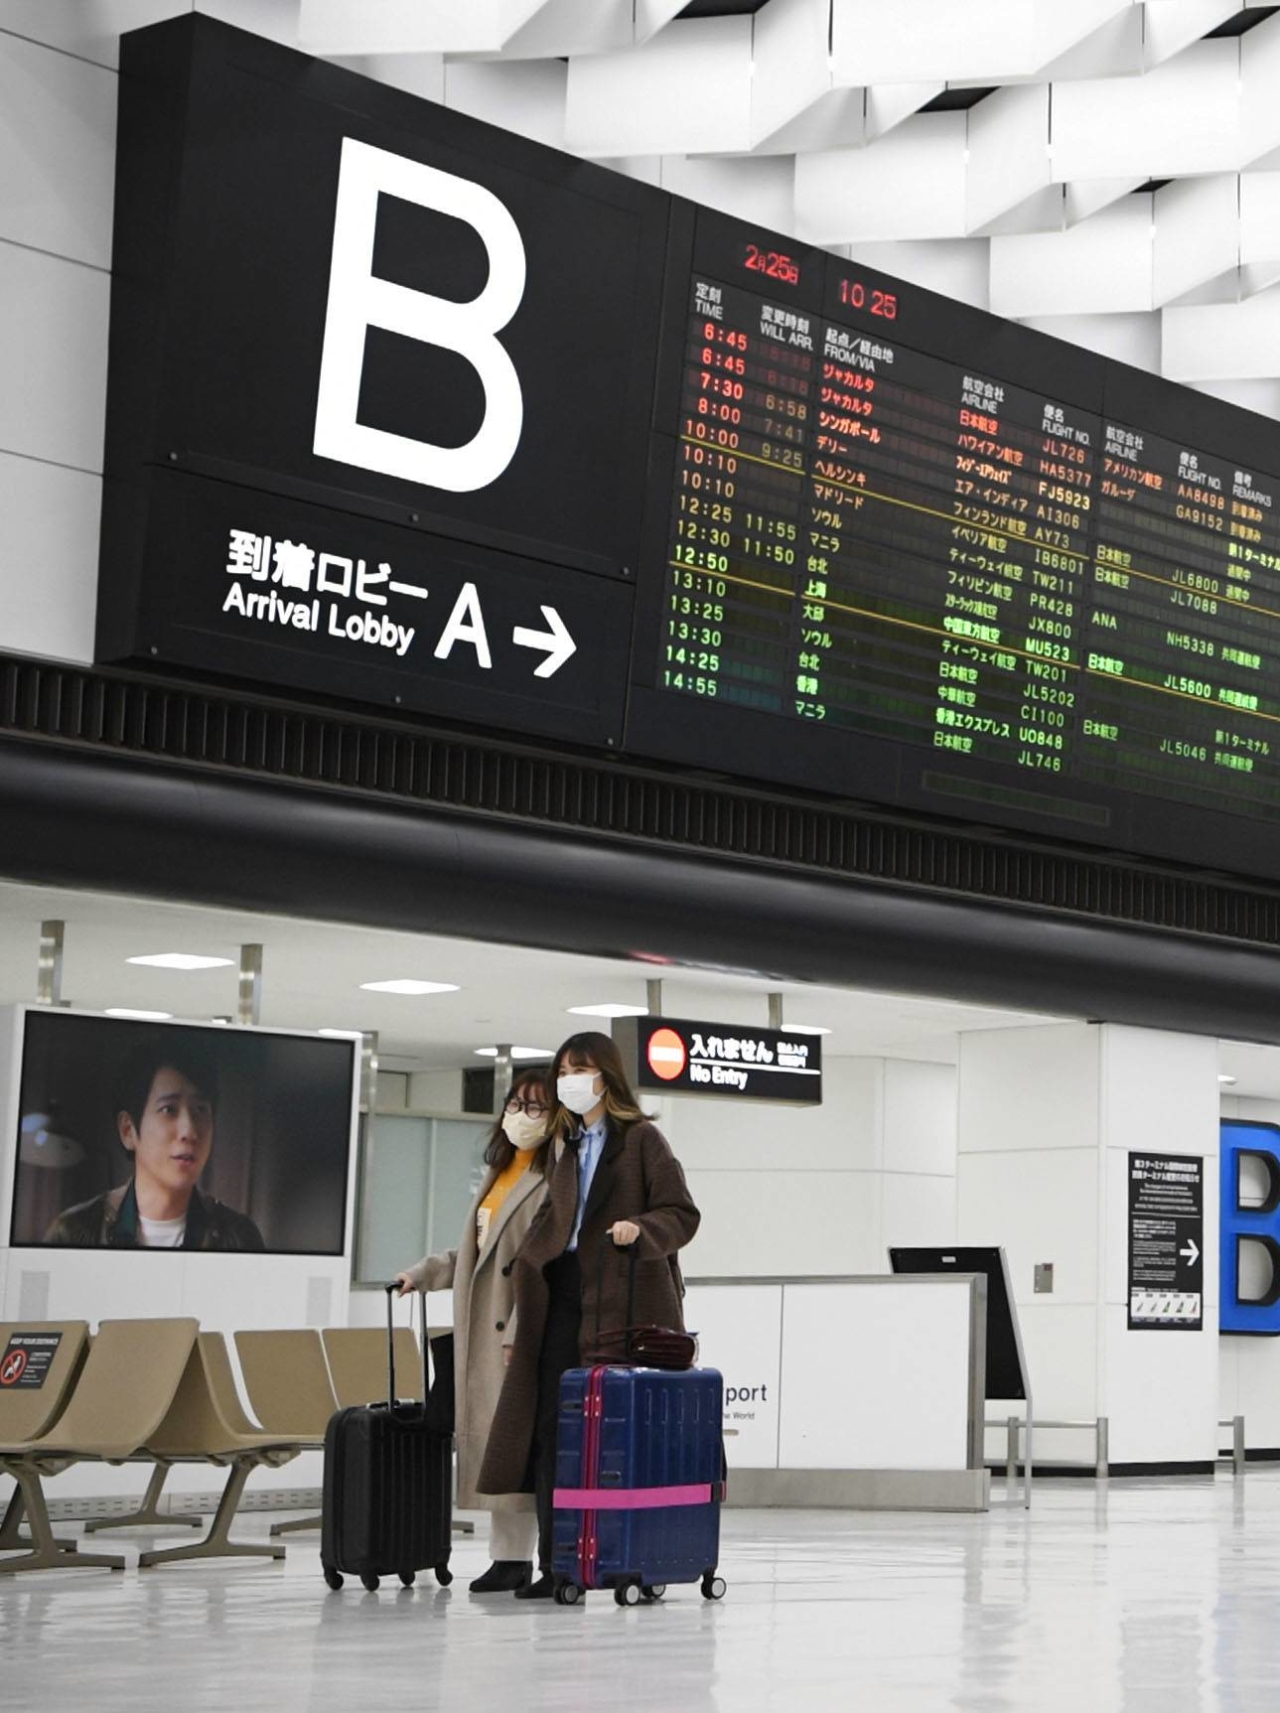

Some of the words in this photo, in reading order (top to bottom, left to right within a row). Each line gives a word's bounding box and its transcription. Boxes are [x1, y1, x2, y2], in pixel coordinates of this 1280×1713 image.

[312, 135, 526, 493] B
[695, 300, 723, 320] TIME
[760, 320, 786, 342] WILL
[961, 392, 997, 414] AIRLINE
[1042, 419, 1073, 440] FLIGHT
[1104, 441, 1137, 462] AIRLINE
[1178, 466, 1206, 485] FLIGHT
[1232, 485, 1271, 507] REMARKS
[699, 398, 740, 424] 8:00
[1037, 505, 1080, 529] AI306
[701, 373, 743, 400] 7:30
[1039, 481, 1090, 510] FJ5923
[702, 348, 745, 376] 6:45
[1040, 460, 1091, 487] HA5377
[1176, 505, 1223, 531] GA9152
[705, 322, 747, 351] 6:45
[1043, 439, 1084, 463] JL726
[1178, 484, 1225, 510] AA8498
[226, 529, 428, 606] 到着ロビー
[682, 470, 734, 499] 10:10
[1032, 571, 1073, 594] TW211
[684, 445, 736, 474] 10:10
[1035, 549, 1083, 575] IB6801
[1170, 591, 1217, 615] JL7088
[686, 419, 739, 448] 10:00
[1035, 527, 1069, 548] AY73
[1172, 569, 1219, 594] JL6800
[222, 582, 319, 631] Arrival
[329, 603, 415, 656] Lobby
[434, 581, 492, 669] A
[673, 570, 726, 597] 13:10
[1026, 660, 1067, 682] TW201
[675, 545, 728, 572] 12:50
[1025, 637, 1070, 661] MU523
[1164, 674, 1211, 698] JL5600
[678, 520, 730, 547] 12:30
[744, 538, 794, 565] 11:50
[1029, 616, 1071, 638] JX800
[680, 495, 732, 523] 12:25
[746, 513, 795, 540] 11:55
[1030, 593, 1073, 617] PR428
[1092, 611, 1117, 630] ANA
[1167, 631, 1214, 657] NH5338
[667, 645, 719, 672] 14:25
[669, 620, 721, 647] 13:30
[1021, 705, 1064, 727] CI100
[1160, 739, 1206, 761] JL5046
[671, 595, 723, 621] 13:25
[1023, 684, 1075, 708] JL5202
[664, 670, 717, 696] 14:55
[1018, 751, 1060, 771] JL746
[690, 1033, 773, 1063] 入れません
[690, 1064, 711, 1083] No
[712, 1067, 748, 1090] Entry
[726, 1384, 767, 1406] port
